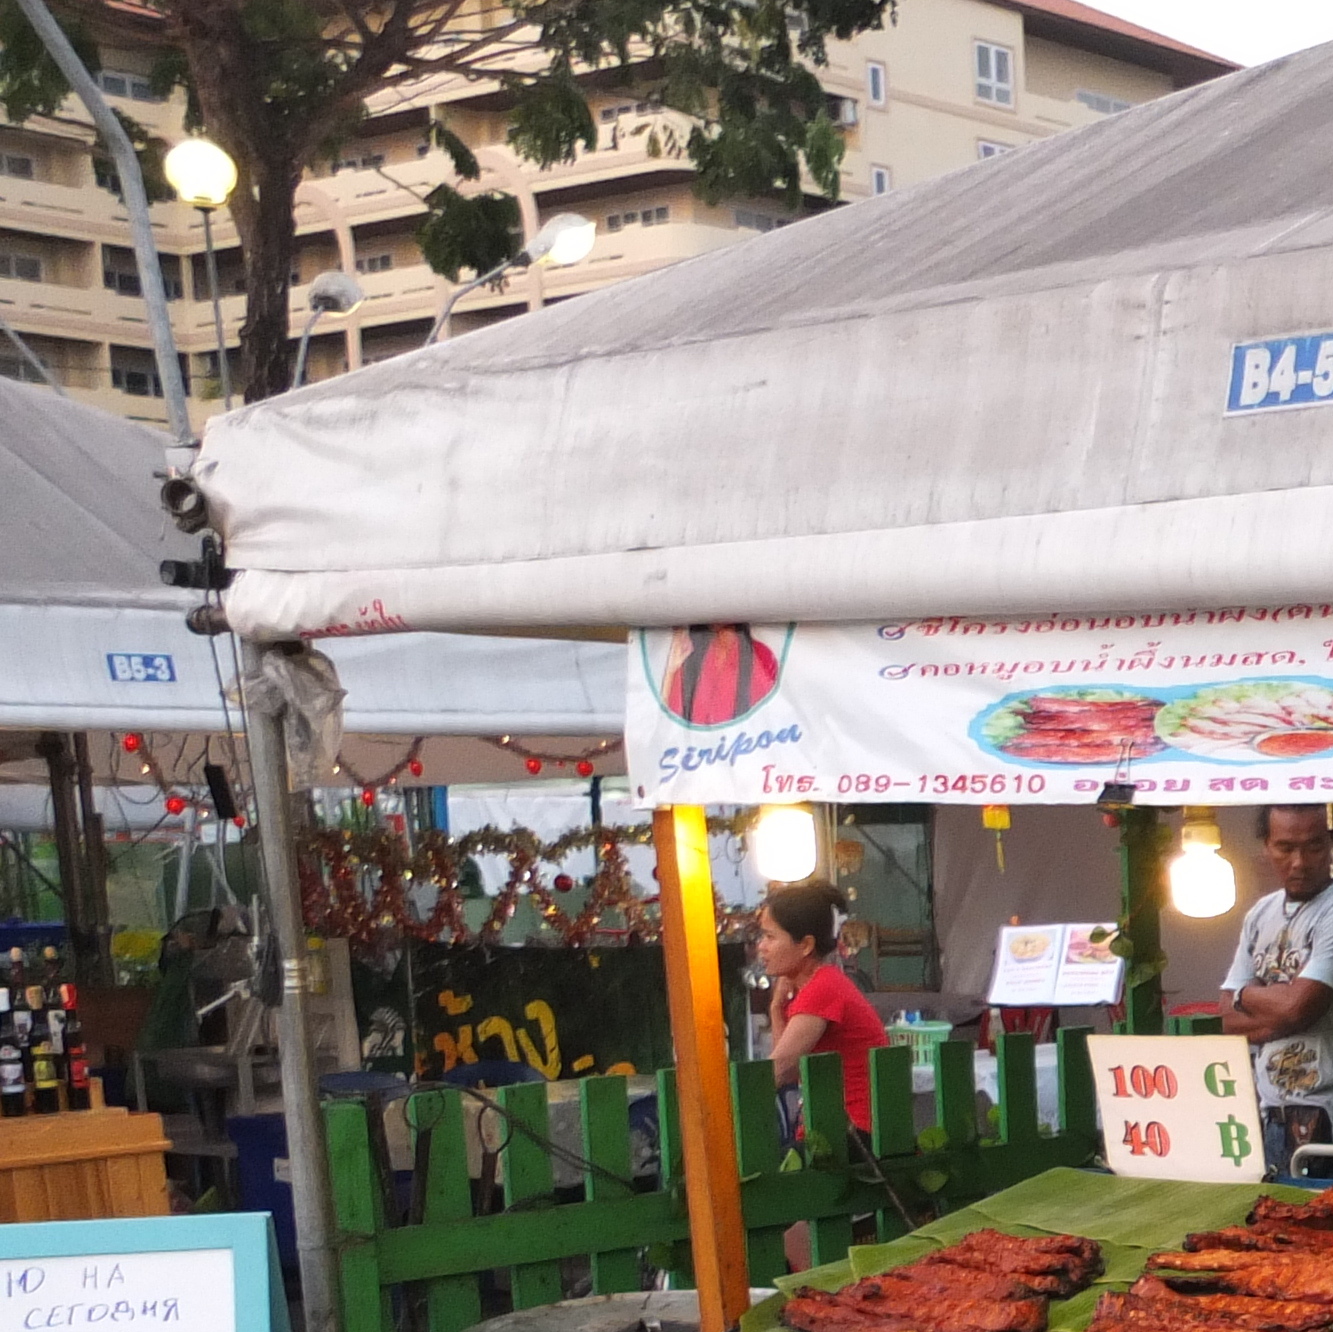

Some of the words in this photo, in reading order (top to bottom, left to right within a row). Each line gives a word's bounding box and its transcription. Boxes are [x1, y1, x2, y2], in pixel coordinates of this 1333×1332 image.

[113, 655, 171, 680] B5-3
[837, 773, 1047, 794] 089-1345610
[1208, 775, 1270, 792] สด
[1109, 1064, 1179, 1099] 100
[1204, 1062, 1237, 1098] G
[1123, 1120, 1171, 1157] 40
[83, 1263, 125, 1289] НА
[24, 1297, 180, 1330] СЕГОДНЯ
